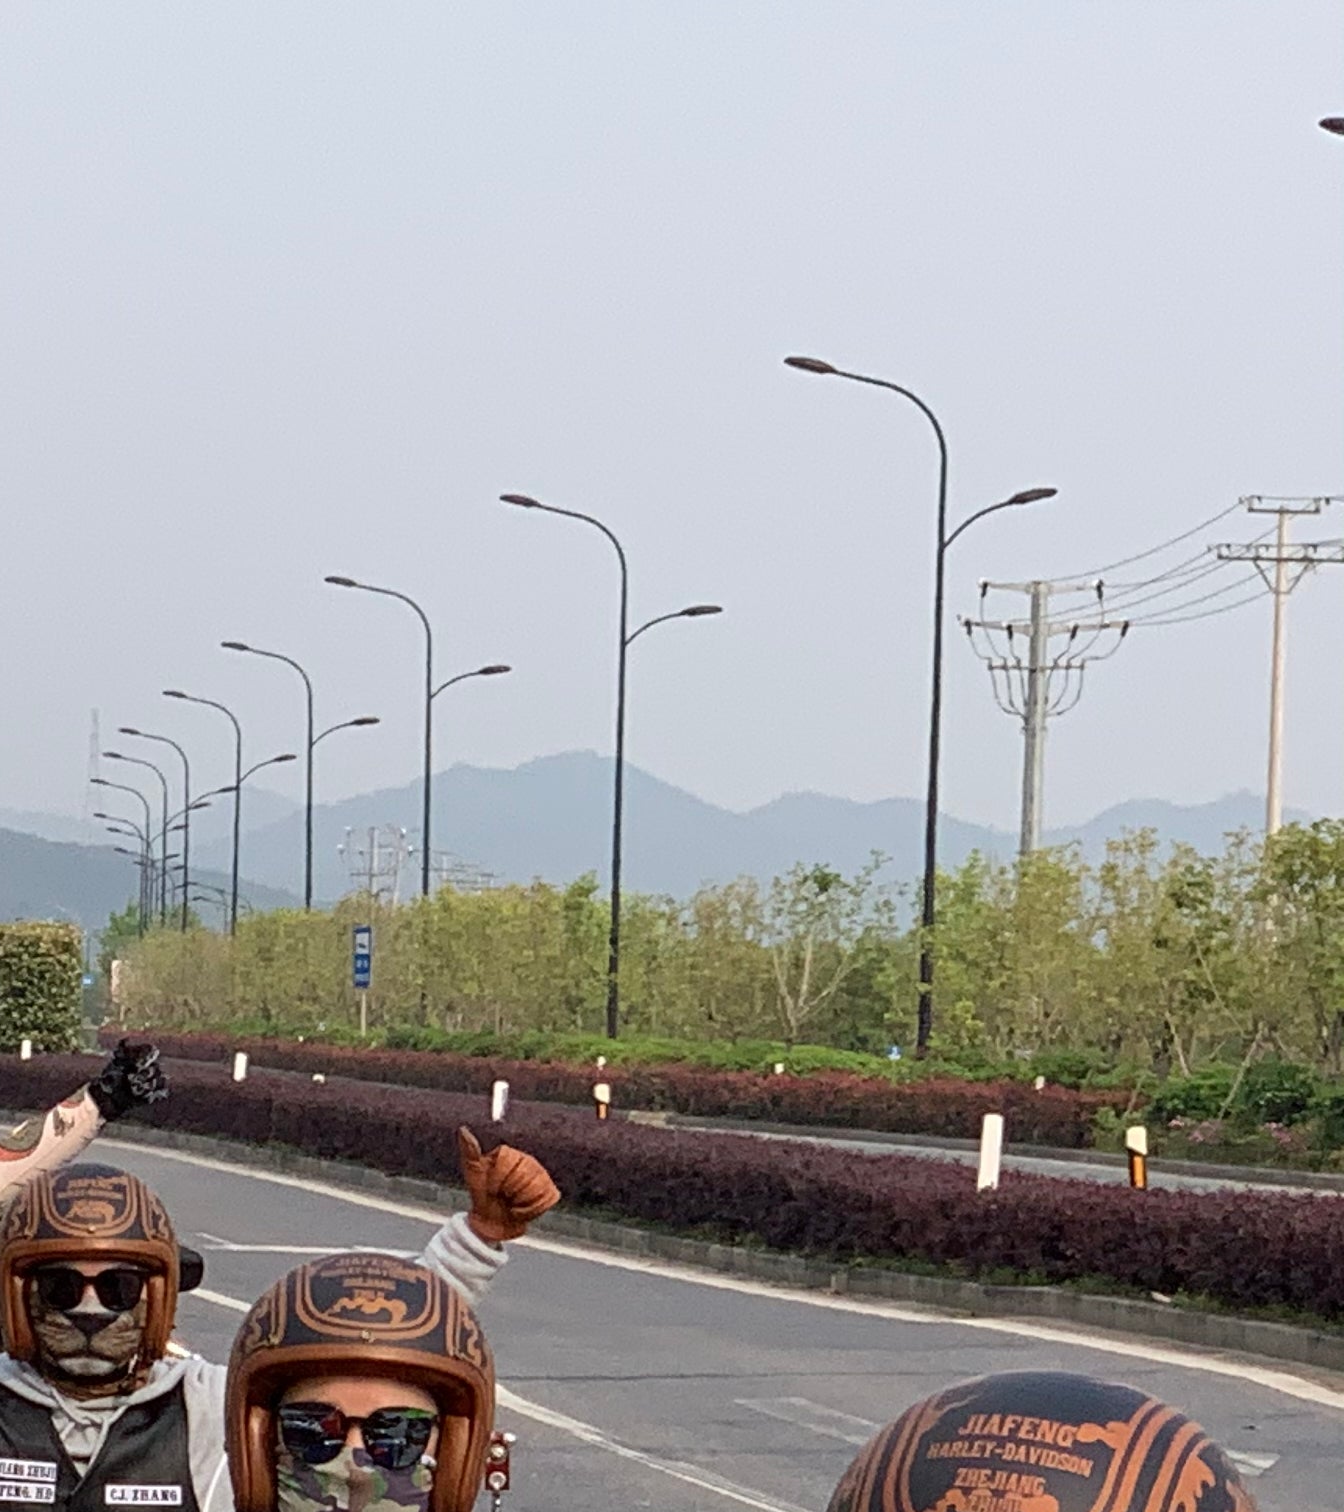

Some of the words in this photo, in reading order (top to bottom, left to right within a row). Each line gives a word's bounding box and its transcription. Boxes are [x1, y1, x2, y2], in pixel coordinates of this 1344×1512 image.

[958, 1413, 1078, 1448] JIAFENG
[926, 1440, 1095, 1479] HARLEY-DAVIDSON
[132, 1488, 178, 1502] ZHANG
[953, 1467, 1047, 1497] ZHEJIANG
